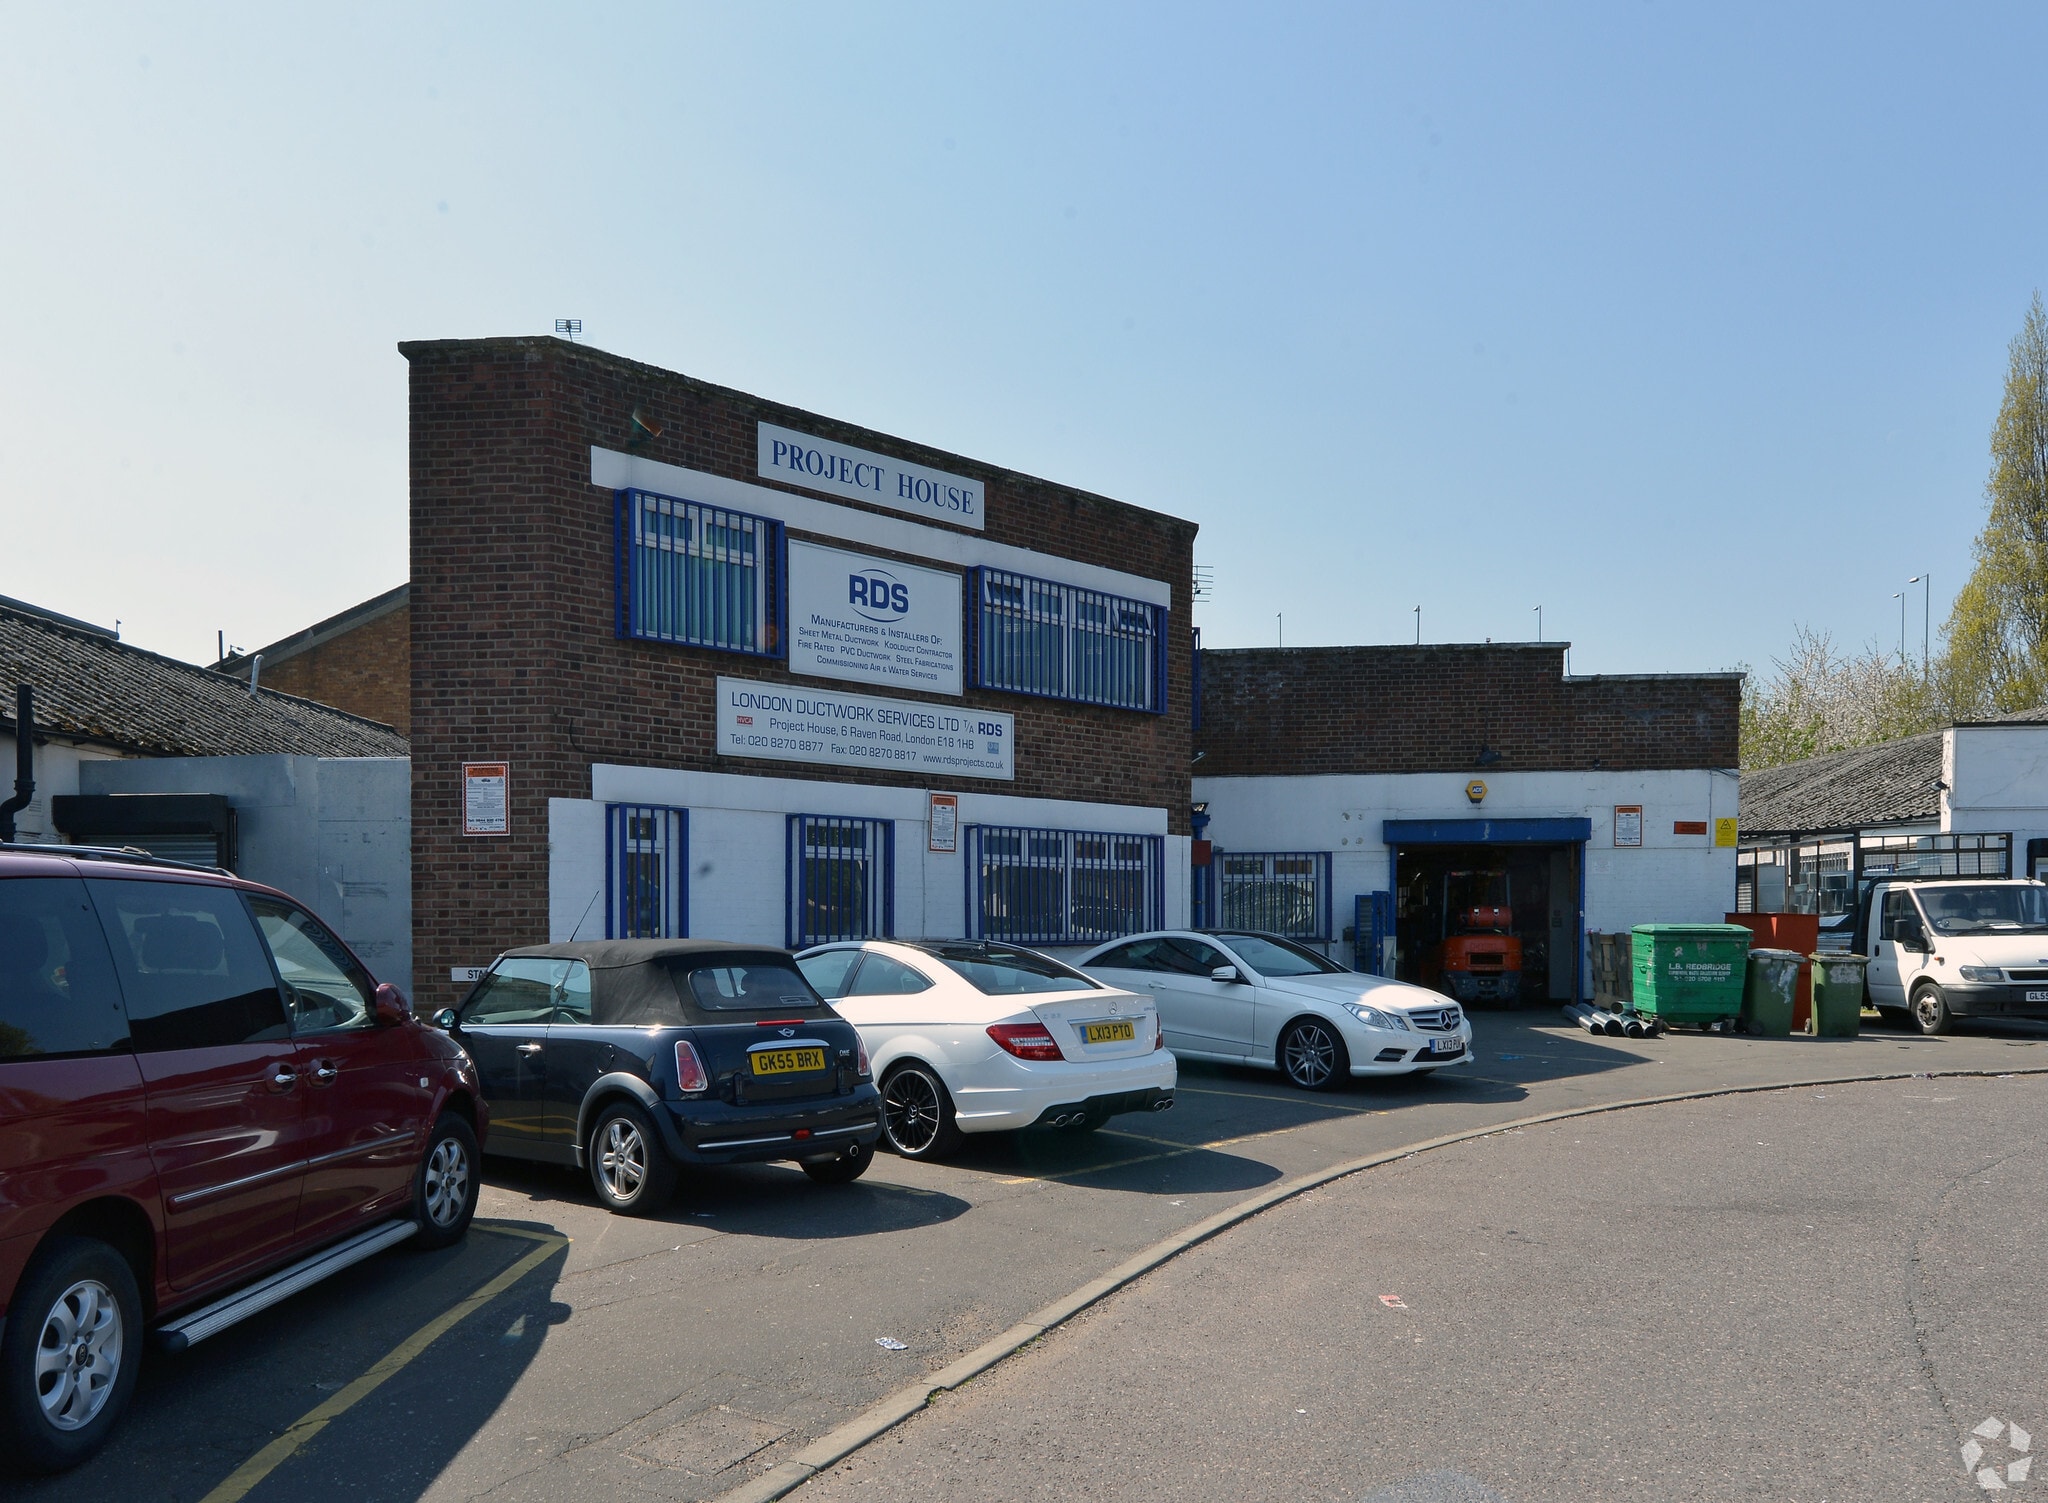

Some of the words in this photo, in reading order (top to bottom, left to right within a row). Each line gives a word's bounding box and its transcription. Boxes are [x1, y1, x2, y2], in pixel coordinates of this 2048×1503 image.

[771, 439, 885, 492] PROJECT
[897, 472, 974, 515] HOUSE
[849, 574, 909, 613] RDS
[799, 626, 820, 638] SHEET
[821, 630, 843, 642] METAL
[844, 634, 879, 647] DUCTWORK
[885, 640, 915, 653] KOOLDUCT
[917, 646, 953, 659] CONTRACTOR
[811, 614, 879, 634] MANUFACTURERS
[881, 628, 886, 636] &
[888, 627, 929, 643] INSTALLERS
[931, 634, 943, 645] OF:
[797, 639, 812, 649] FIRE
[814, 642, 835, 653] RATED
[840, 645, 855, 656] PVC
[857, 648, 891, 661] DUCTWORK
[896, 654, 914, 665] STEEL
[915, 657, 954, 671] FABRICATIONS
[816, 655, 868, 670] COMMISSIONING
[870, 663, 880, 672] AIR
[888, 665, 909, 676] WATER
[911, 668, 938, 681] SERVICES
[731, 691, 792, 713] LONDON
[797, 699, 874, 722] DUCTWORK
[877, 709, 935, 729] SERVICES
[938, 716, 960, 732] LTD
[978, 721, 1003, 737] RDS
[769, 717, 804, 733] Project
[807, 722, 838, 737] House,
[841, 725, 847, 736] 6
[850, 726, 877, 740] Raven
[880, 730, 903, 743] Road,
[905, 733, 936, 746] London
[938, 736, 954, 748] E18
[957, 738, 975, 750] 1HB
[730, 733, 746, 745] Tel:
[748, 735, 768, 747] 020
[770, 737, 797, 750] 8270
[799, 740, 824, 752] 8877
[831, 743, 847, 754] Fax:
[849, 745, 867, 757] 020
[869, 747, 893, 759] 8270
[894, 749, 917, 761] 8817
[923, 754, 1004, 770] www.rdsprojects.co.uk
[467, 969, 484, 979] STA
[1686, 963, 1732, 971] REDBRIDGE
[1088, 1025, 1110, 1041] LX13
[1437, 1039, 1453, 1051] LX13
[758, 1053, 794, 1071] GK55
[796, 1051, 821, 1068] BRX
